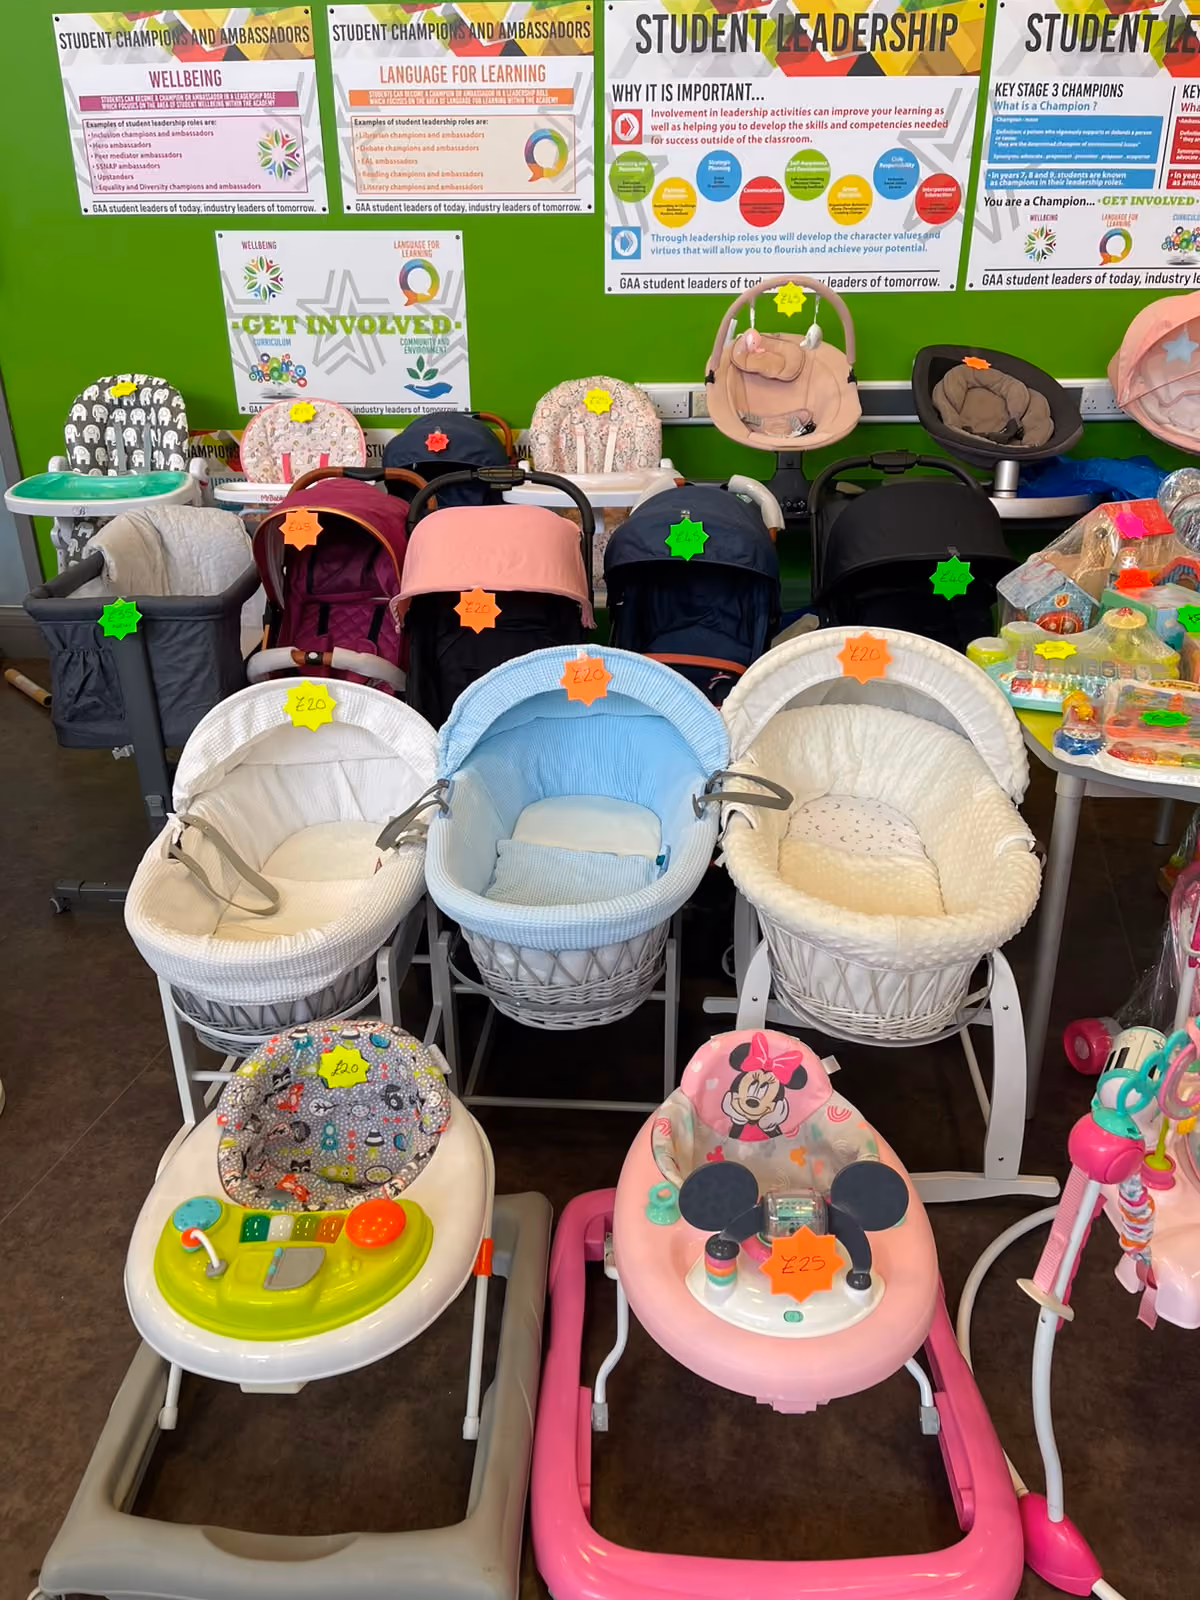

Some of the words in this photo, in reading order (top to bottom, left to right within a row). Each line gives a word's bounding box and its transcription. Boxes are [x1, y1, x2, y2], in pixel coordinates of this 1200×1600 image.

[59, 31, 113, 49] STUDENT
[116, 29, 188, 47] CHAMPIONS
[191, 28, 216, 45] AND
[220, 26, 310, 44] AMBASSADORS
[332, 23, 388, 41] STUDENT
[391, 22, 465, 40] CHAMPIONS
[470, 22, 494, 39] AND
[499, 21, 591, 39] AMBASSADORS
[635, 13, 768, 54] STUDENT
[776, 11, 959, 53] LEADERSHIP
[1025, 12, 1159, 53] STUDENT
[148, 69, 222, 87] WELLBEING
[380, 65, 448, 83] LANGUAGE
[452, 64, 477, 83] FOR
[481, 64, 546, 82] LEARNING
[612, 84, 642, 102] WHY
[645, 84, 657, 102] IT
[661, 83, 673, 102] IS
[995, 83, 1016, 97] KEY
[1017, 83, 1049, 97] STAGE
[1052, 83, 1059, 97] 3
[1062, 83, 1124, 98] CHAMPIONS
[651, 108, 707, 117] Involvement
[709, 108, 718, 117] in
[720, 108, 768, 119] leadership
[770, 107, 811, 116] activities
[831, 107, 869, 118] improve
[871, 108, 892, 117] your
[894, 106, 932, 117] learning
[993, 101, 1019, 110] What
[1021, 101, 1030, 110] is
[1040, 101, 1090, 113] Champion
[1093, 101, 1098, 111] ?
[354, 119, 386, 127] Examples
[422, 118, 457, 126] leadership
[651, 122, 669, 131] well
[683, 122, 717, 133] helping
[719, 123, 736, 133] you
[738, 122, 748, 130] to
[750, 121, 786, 132] develop
[788, 121, 804, 130] the
[805, 121, 829, 130] skills
[830, 121, 847, 130] and
[849, 120, 913, 131] competencies
[914, 120, 948, 129] needed
[651, 136, 663, 144] for
[700, 135, 735, 144] outside
[737, 135, 746, 144] of
[748, 135, 763, 144] the
[764, 135, 813, 144] classroom.
[999, 179, 1038, 187] champions
[1065, 179, 1103, 187] leadership
[355, 203, 371, 212] GAA
[372, 203, 402, 211] student
[403, 203, 432, 211] leaders
[434, 203, 442, 211] of
[443, 203, 467, 213] today,
[468, 203, 500, 213] industry
[502, 203, 531, 211] leaders
[532, 203, 541, 211] of
[543, 203, 582, 211] tomorrow.
[984, 196, 1003, 206] You
[1005, 198, 1022, 206] are
[1024, 198, 1030, 206] a
[1102, 196, 1129, 206] GET
[1130, 196, 1195, 206] INVOLVED
[651, 233, 687, 243] Through
[689, 232, 736, 243] leadership
[737, 232, 759, 241] roles
[761, 234, 777, 243] you
[779, 232, 794, 240] will
[796, 232, 832, 242] develop
[833, 232, 849, 240] the
[850, 231, 892, 240] character
[893, 231, 920, 240] values
[922, 231, 940, 239] and
[241, 240, 277, 250] WELLBEING
[393, 240, 426, 249] LANGUAGE
[428, 240, 440, 249] FOR
[651, 246, 681, 255] virtues
[683, 246, 700, 254] that
[702, 246, 718, 254] will
[720, 245, 743, 254] allow
[745, 247, 761, 256] you
[763, 245, 772, 254] to
[774, 245, 807, 254] flourish
[809, 245, 826, 253] and
[828, 245, 861, 253] achieve
[863, 246, 883, 255] your
[885, 244, 928, 255] potential.
[402, 249, 433, 258] LEARNING
[619, 277, 640, 289] GAA
[643, 277, 685, 289] student
[688, 277, 727, 288] leaders
[730, 277, 742, 288] of
[827, 276, 868, 287] leaders
[870, 276, 882, 287] of
[884, 276, 940, 287] tomorrow.
[982, 273, 1003, 285] GAA
[1006, 273, 1049, 285] student
[1051, 273, 1093, 285] leaders
[1095, 273, 1108, 285] of
[1109, 272, 1141, 287] today,
[1145, 272, 1191, 287] industry
[241, 314, 299, 335] GET
[306, 314, 452, 335] INVOLVED
[254, 337, 291, 346] CURRICULUM
[354, 405, 384, 415] industry
[385, 405, 412, 413] leaders
[413, 405, 420, 413] of
[422, 405, 458, 413] tomorrow
[288, 521, 311, 532] £45
[676, 529, 700, 543] £45
[940, 569, 966, 583] £40
[464, 600, 491, 614] £20
[107, 608, 133, 622] £35
[849, 644, 881, 663] £20
[573, 667, 605, 684] £20
[295, 696, 327, 713] £20
[331, 1060, 359, 1077] £20
[781, 1254, 826, 1275] £25
